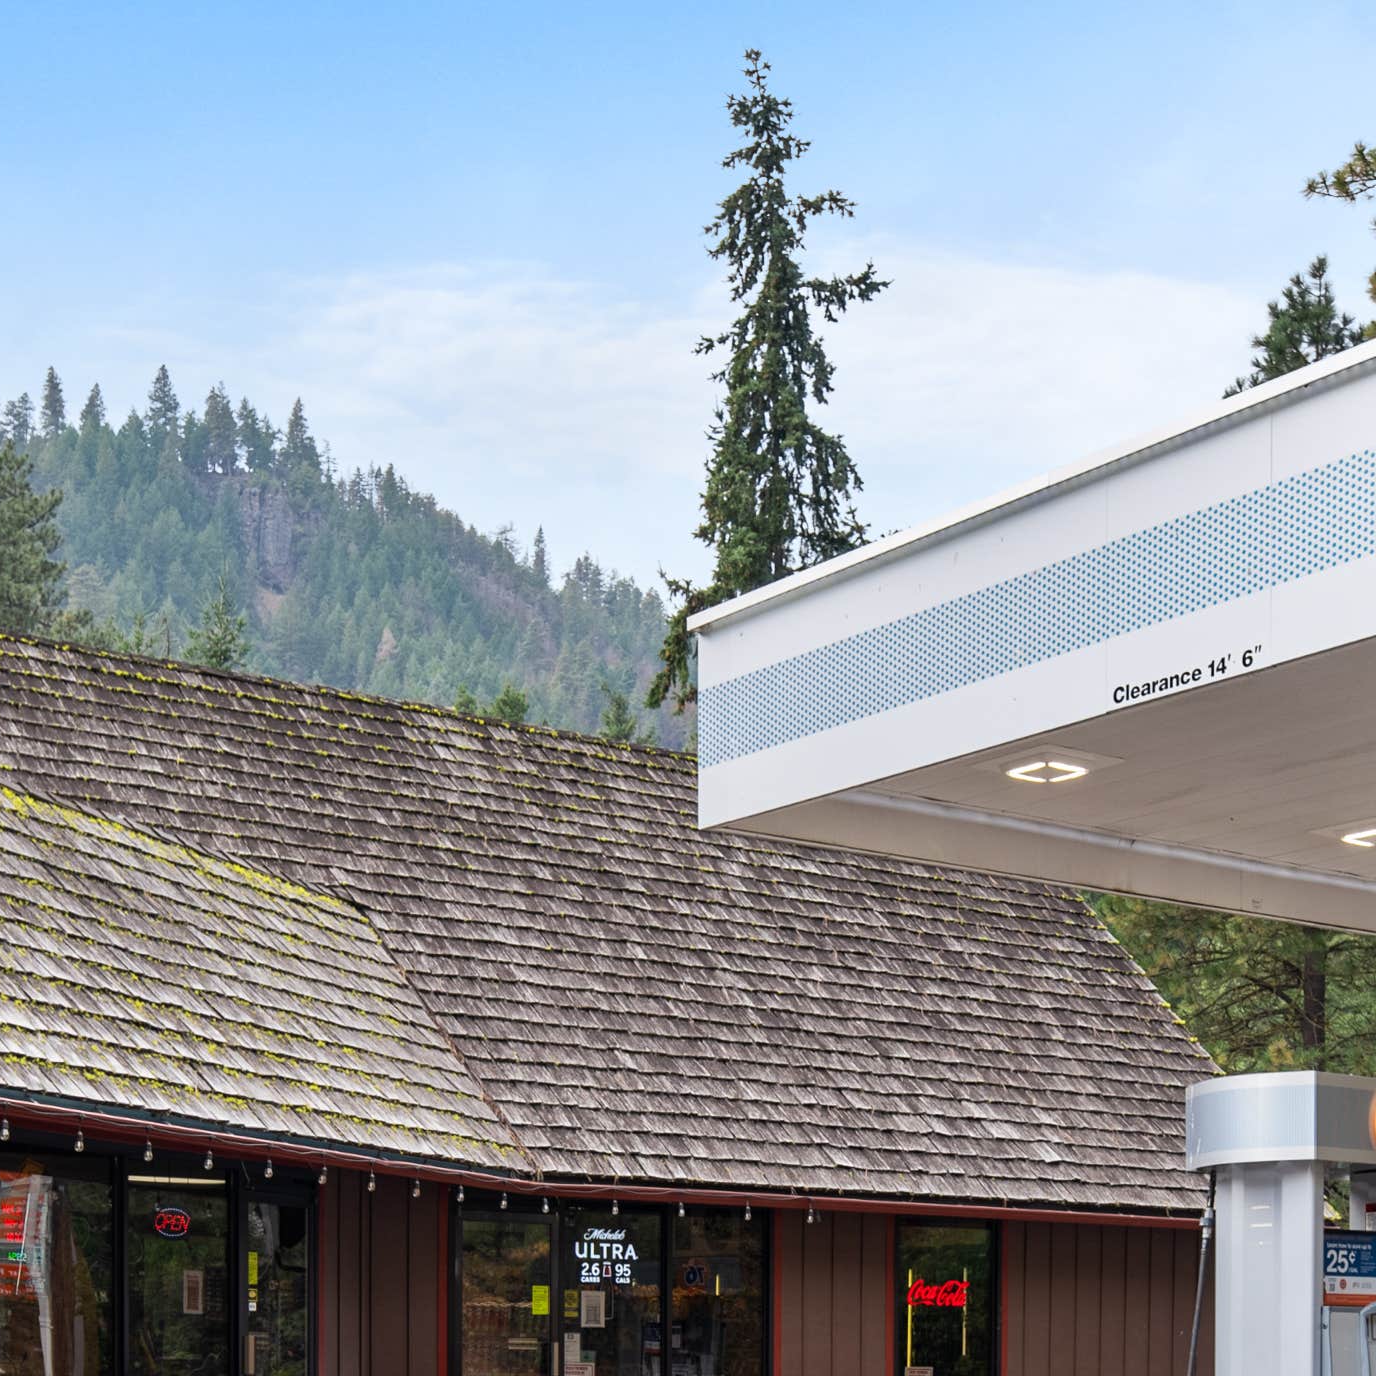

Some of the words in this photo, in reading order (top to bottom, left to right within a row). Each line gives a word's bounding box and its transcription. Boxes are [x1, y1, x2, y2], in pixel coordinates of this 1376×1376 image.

[1113, 667, 1202, 704] Clearance
[1207, 653, 1231, 677] 14'
[1241, 644, 1262, 668] 6"
[155, 1213, 191, 1232] OPEN
[583, 1228, 627, 1241] Michelob
[575, 1241, 638, 1260] ULTRA
[581, 1261, 600, 1276] 2.6
[614, 1263, 631, 1277] 95
[1326, 1249, 1356, 1273] 25¢
